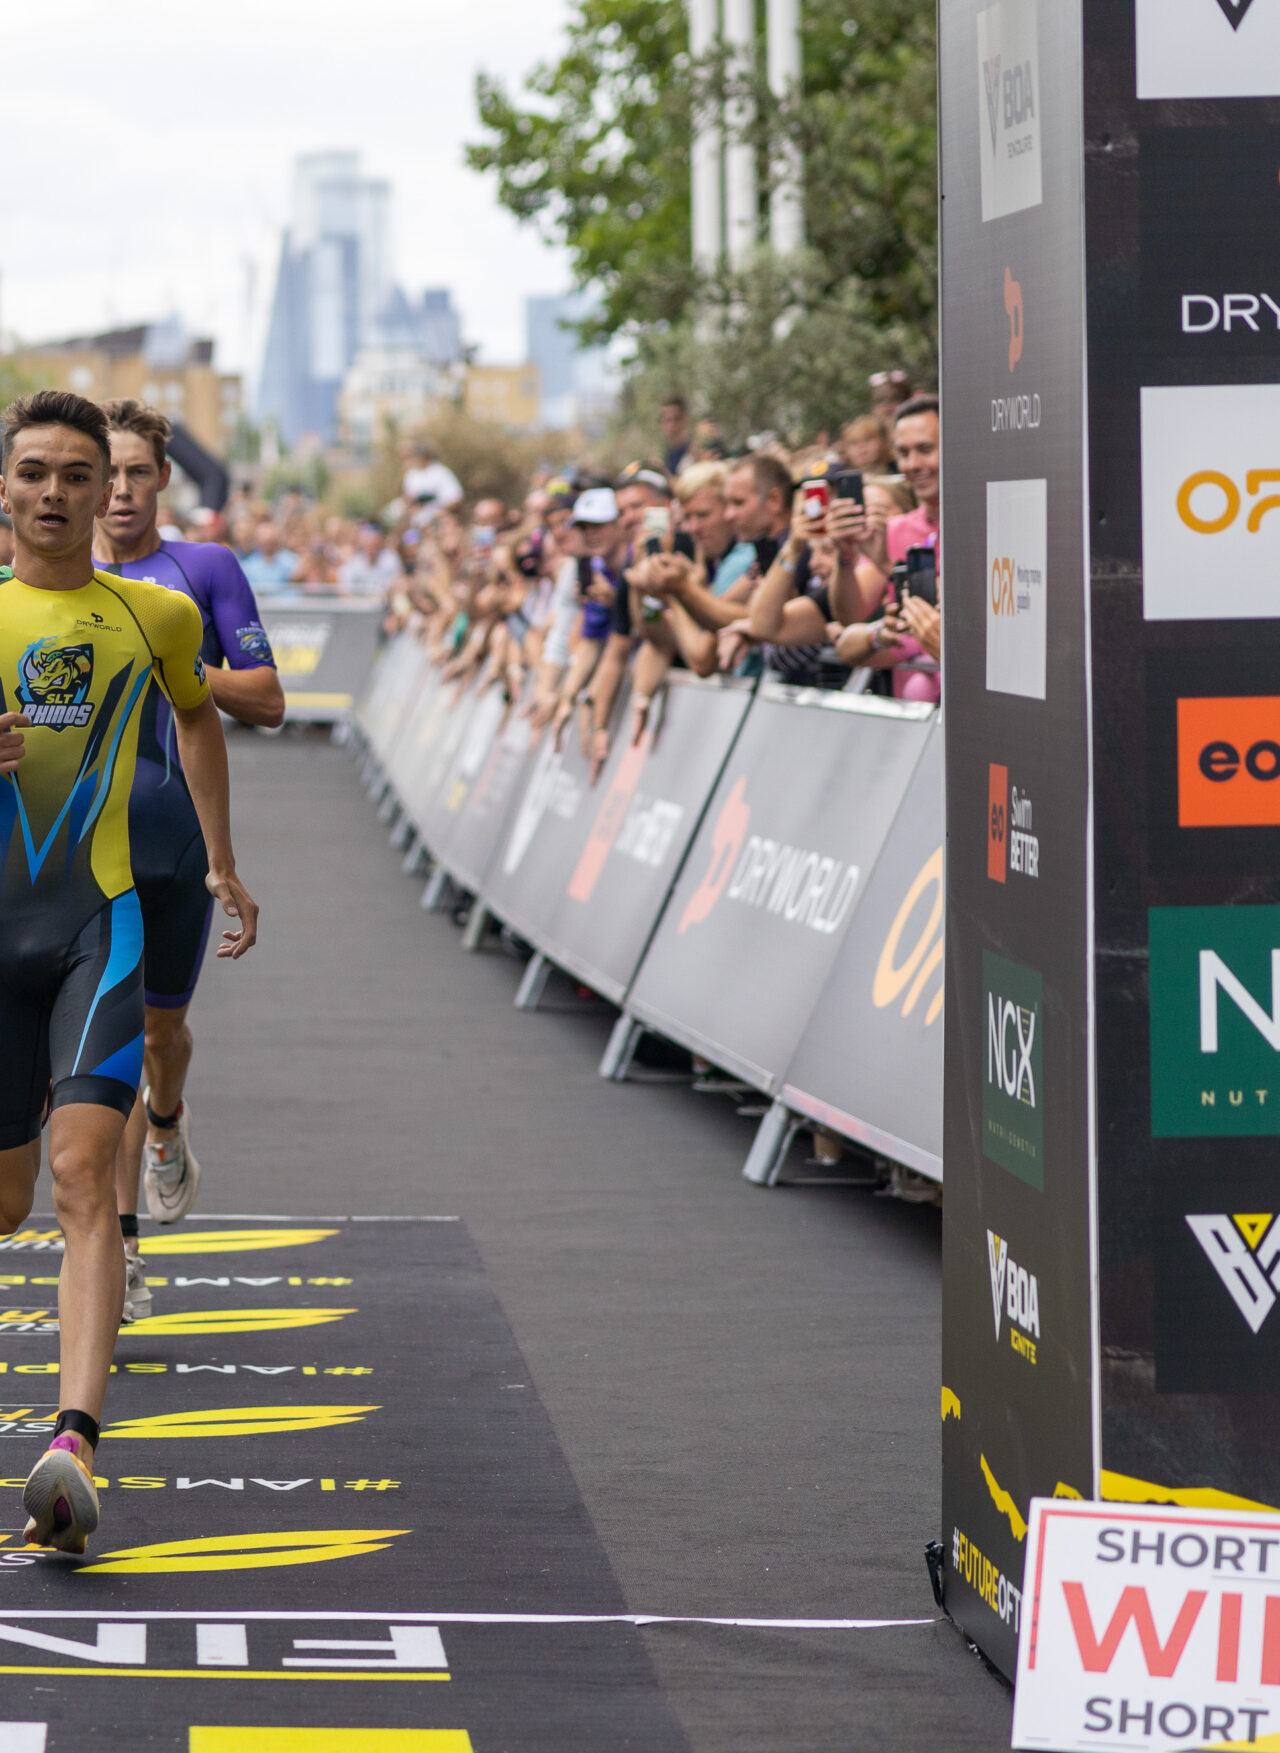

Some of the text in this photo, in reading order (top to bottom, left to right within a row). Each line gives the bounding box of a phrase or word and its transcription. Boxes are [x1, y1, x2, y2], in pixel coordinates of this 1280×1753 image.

[1003, 60, 1034, 130] BOA
[991, 393, 1041, 432] DRYWORLD
[991, 557, 1015, 616] OFX
[76, 619, 123, 632] DRYWORLD
[22, 703, 93, 726] RHINOS
[45, 693, 74, 704] SLT
[1198, 739, 1280, 783] eo
[991, 803, 1004, 843] eo
[1011, 785, 1033, 830] Swim
[1010, 830, 1040, 879] BETTER
[727, 835, 860, 934] DRYWORLD
[1007, 1257, 1041, 1340] BOA
[1010, 1327, 1037, 1366] IGNITE
[1096, 1527, 1280, 1573] SHORT
[1061, 1580, 1280, 1686] WI
[1083, 1695, 1270, 1744] SHORT
